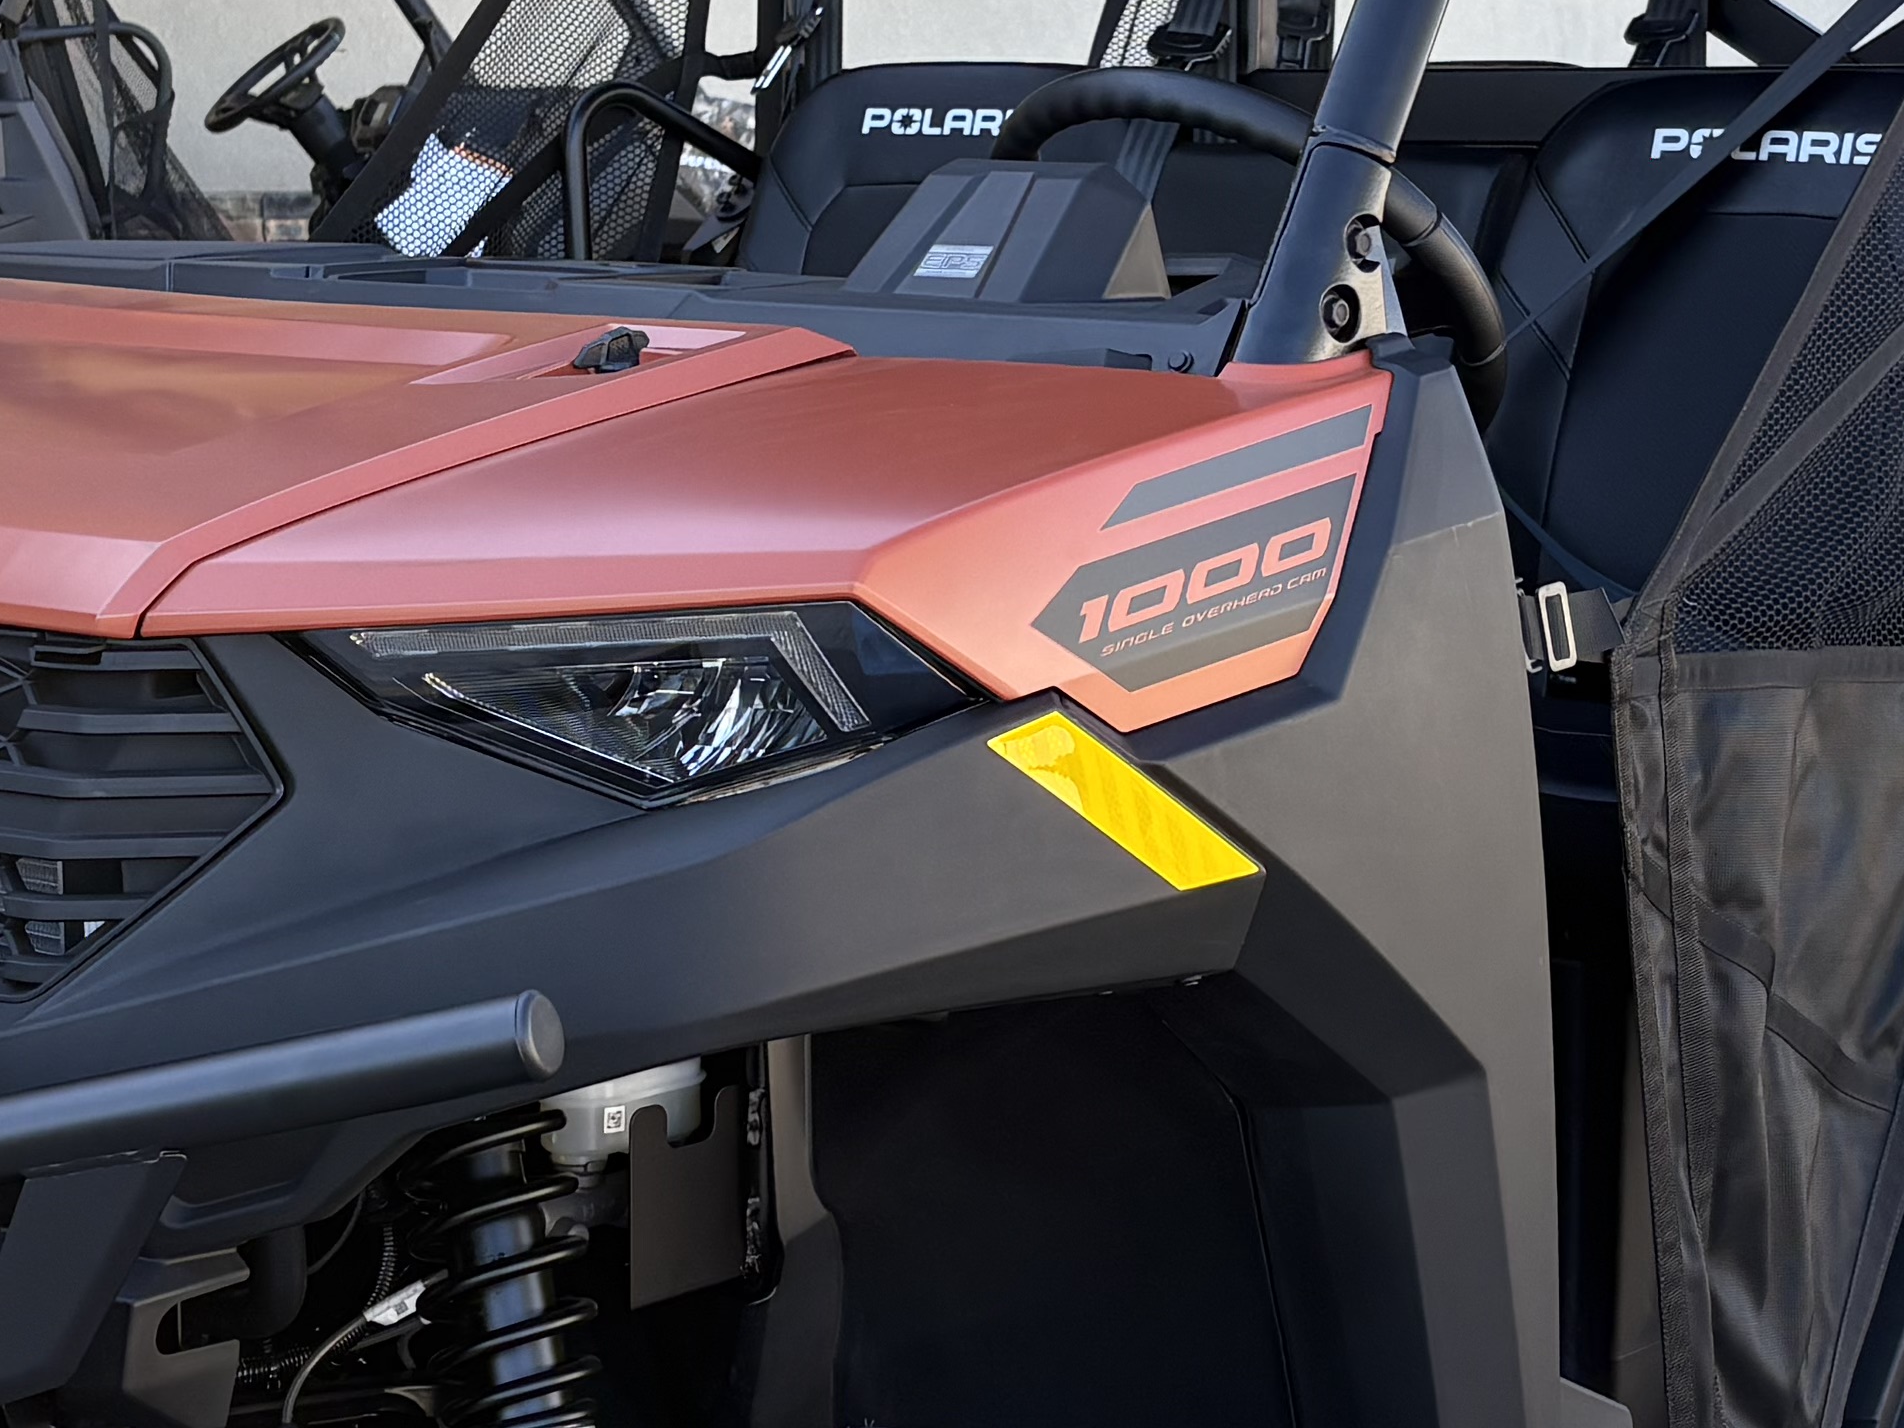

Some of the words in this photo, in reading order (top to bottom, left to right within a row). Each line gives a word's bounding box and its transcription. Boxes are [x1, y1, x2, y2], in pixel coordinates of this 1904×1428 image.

[861, 107, 1015, 137] POLAR
[1078, 516, 1332, 644] 1000
[1099, 621, 1174, 657] SINGLE
[1181, 582, 1284, 629] OVERHEAD
[1286, 566, 1328, 591] CAM
